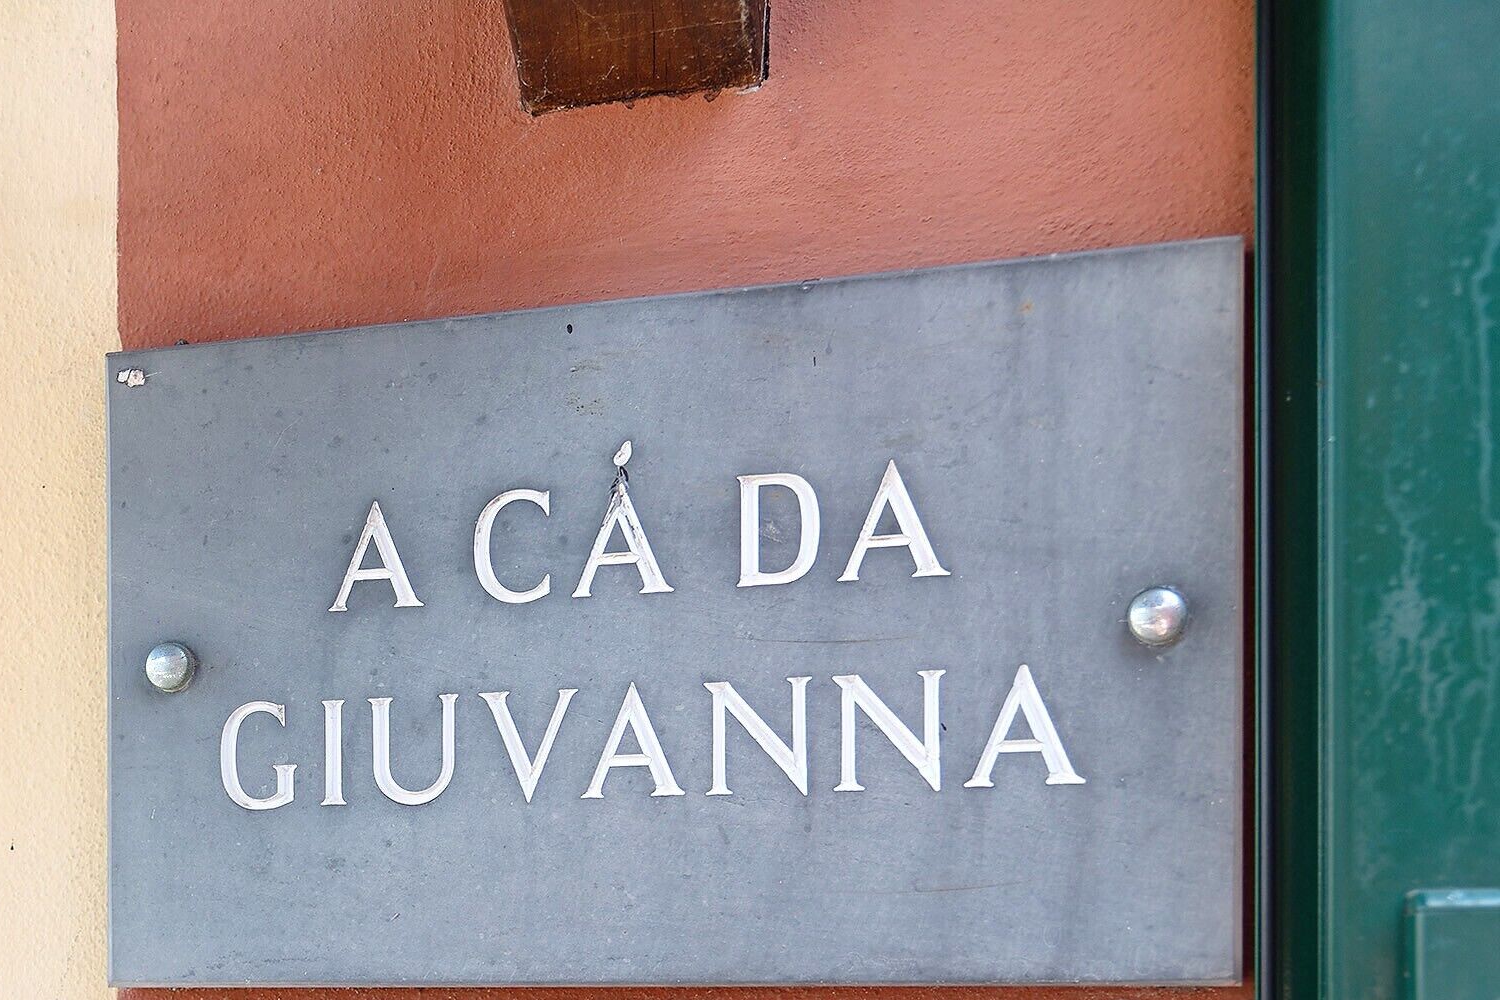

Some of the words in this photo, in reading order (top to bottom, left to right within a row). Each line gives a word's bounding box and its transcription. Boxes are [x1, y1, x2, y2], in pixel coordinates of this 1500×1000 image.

[327, 500, 426, 612] A
[735, 459, 952, 589] DA
[219, 663, 1088, 811] GIUVANNA
